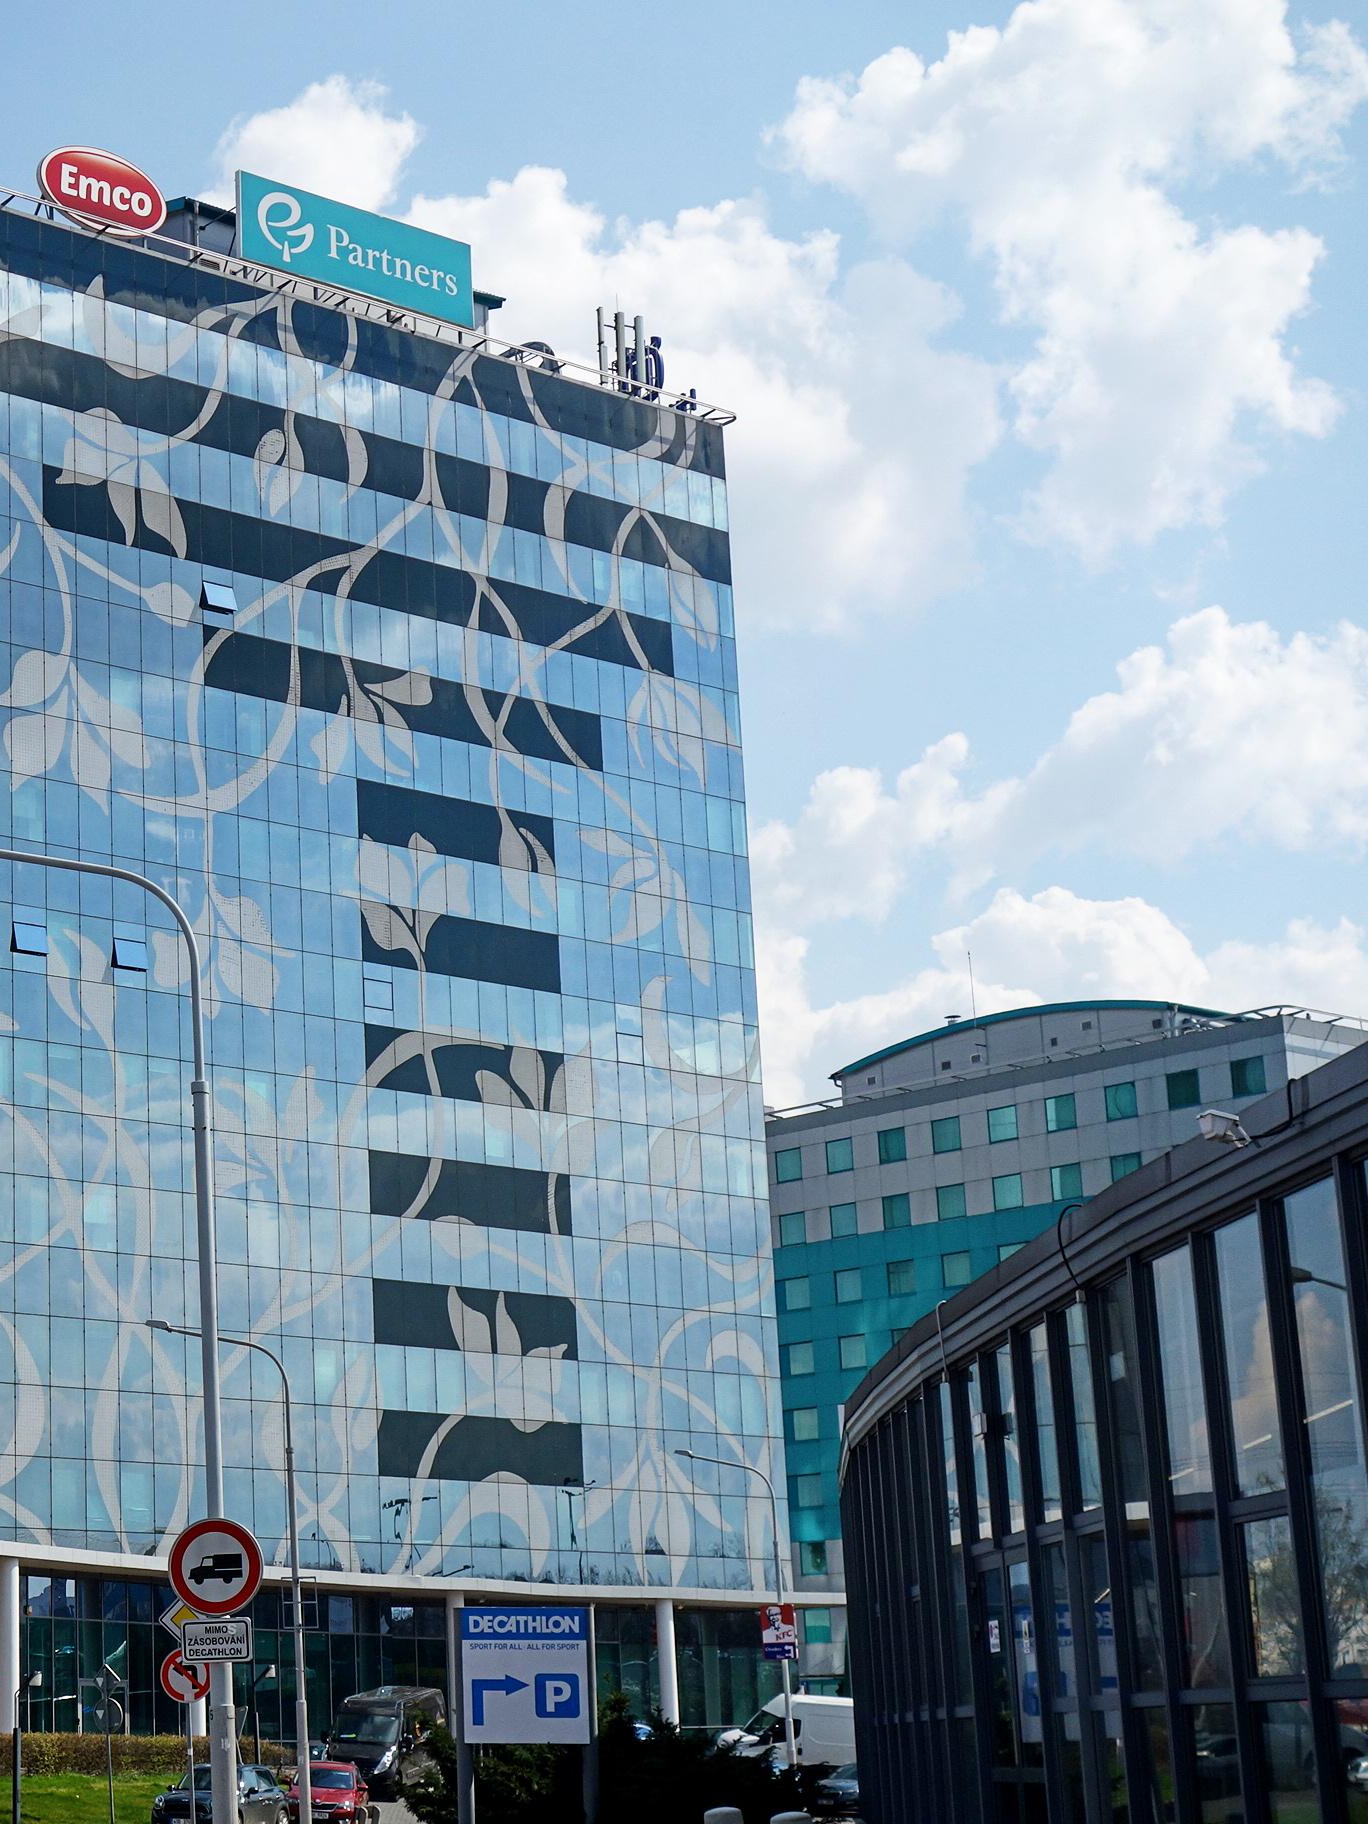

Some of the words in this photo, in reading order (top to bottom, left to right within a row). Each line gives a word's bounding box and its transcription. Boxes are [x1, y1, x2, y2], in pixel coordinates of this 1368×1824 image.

[60, 162, 153, 217] Emco
[326, 224, 458, 296] Partners
[468, 1615, 580, 1634] DECATHLON
[187, 1636, 245, 1647] ZÁSOBOVÁNÍ
[775, 1630, 793, 1641] KFC
[188, 1648, 243, 1657] DECATHLON
[545, 1680, 572, 1713] P
